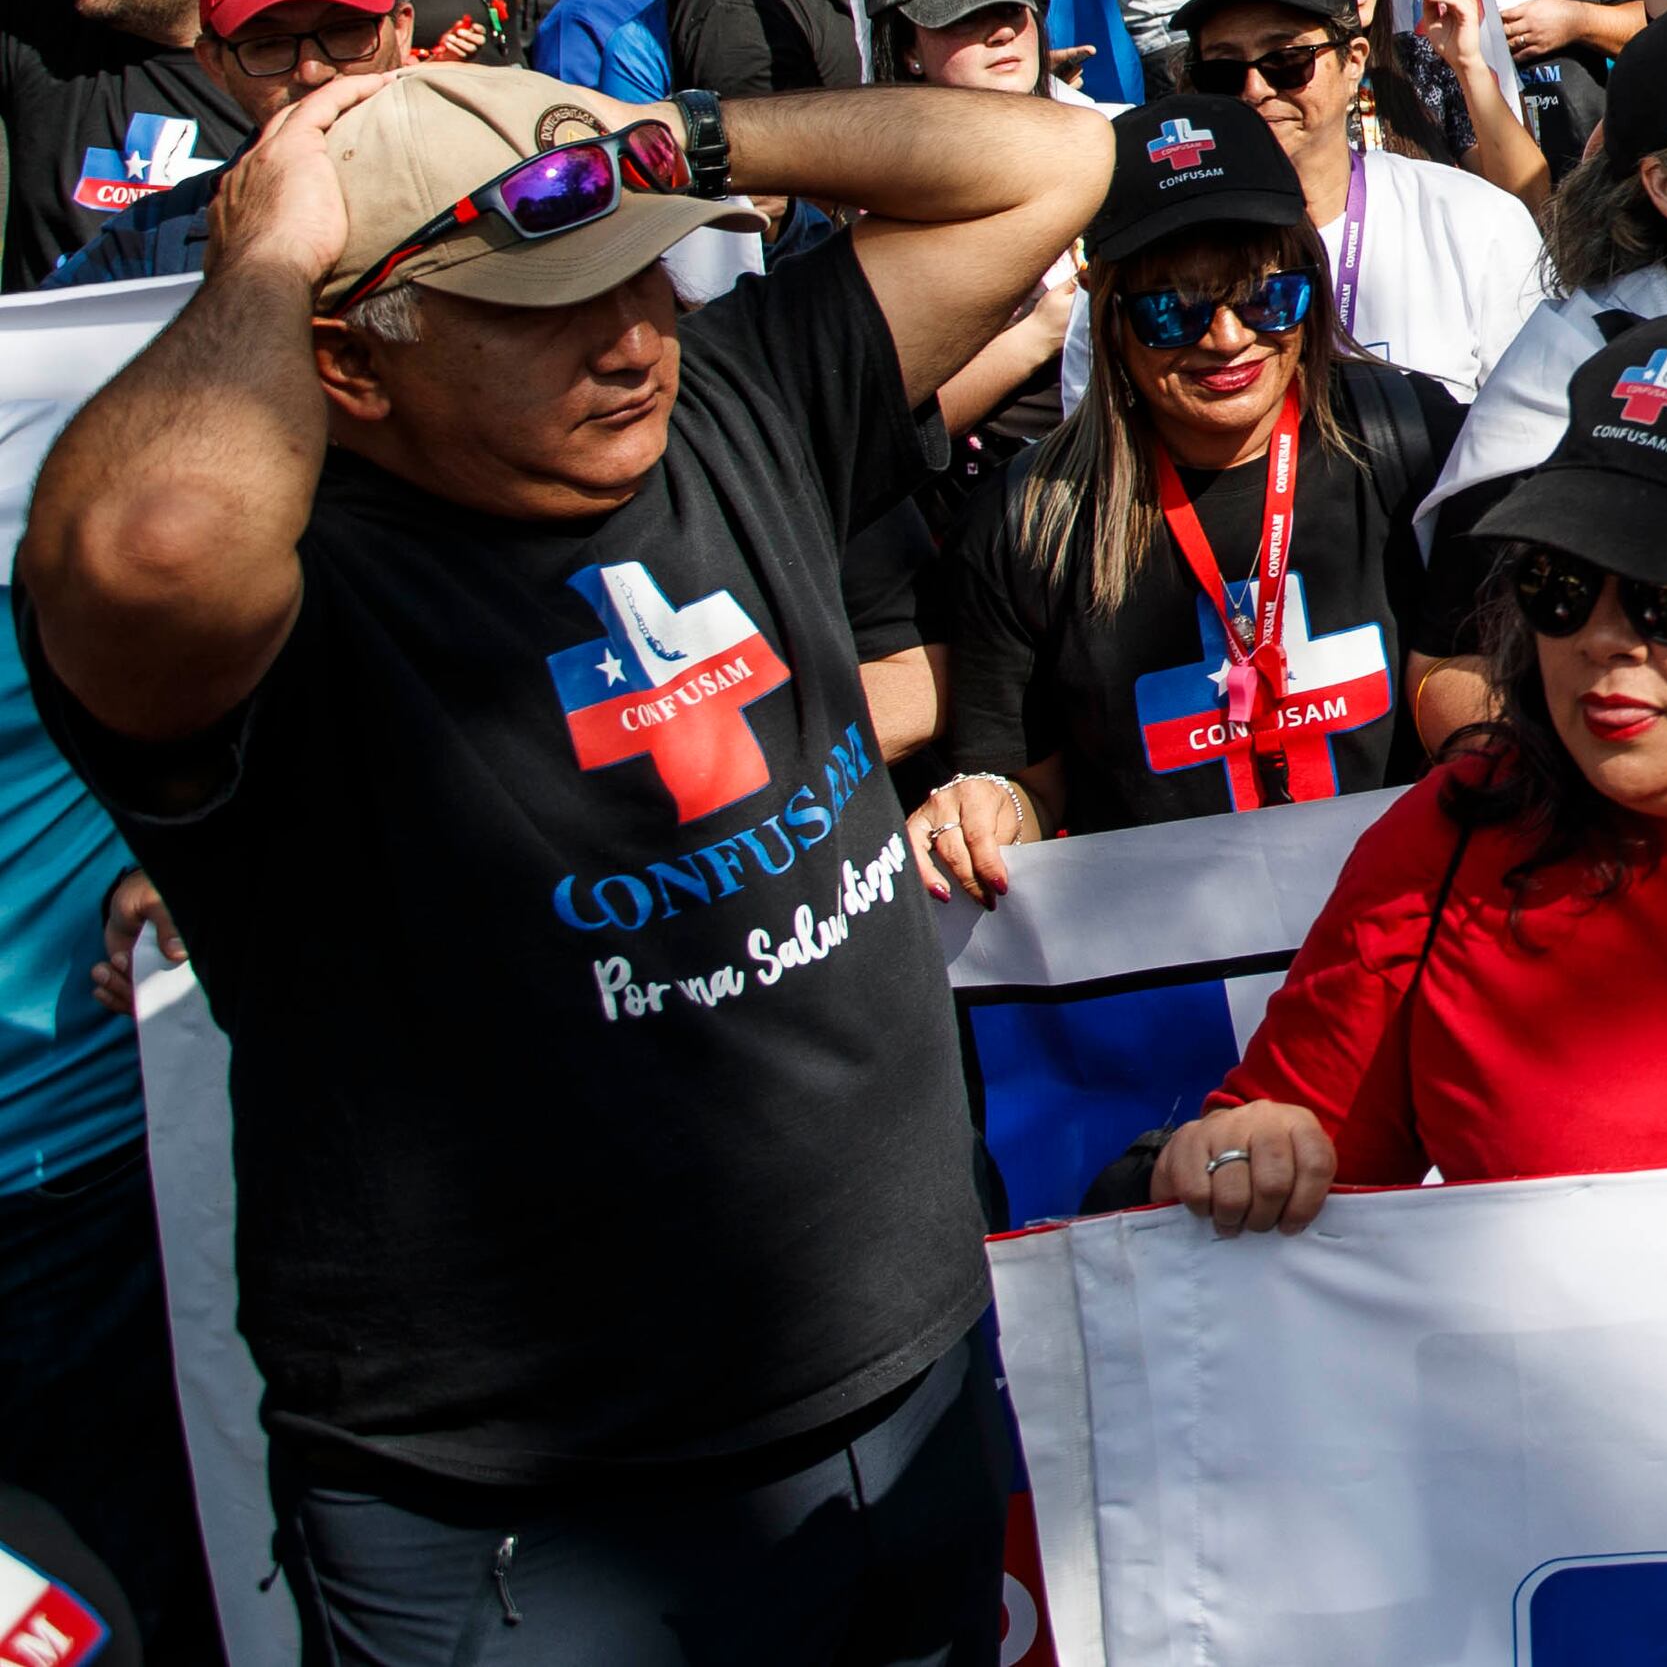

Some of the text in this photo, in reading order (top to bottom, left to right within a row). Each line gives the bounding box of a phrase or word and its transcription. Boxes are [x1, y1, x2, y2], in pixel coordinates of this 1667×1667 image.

[1158, 167, 1225, 190] CONFUSAM
[1344, 220, 1359, 270] CONFUSAM
[1274, 433, 1293, 494] CONFUSAM
[1267, 513, 1286, 578] CONFUSAM
[619, 656, 754, 733] CONFUSAM
[551, 720, 874, 934] CONFUSAM
[593, 955, 671, 1024] Por
